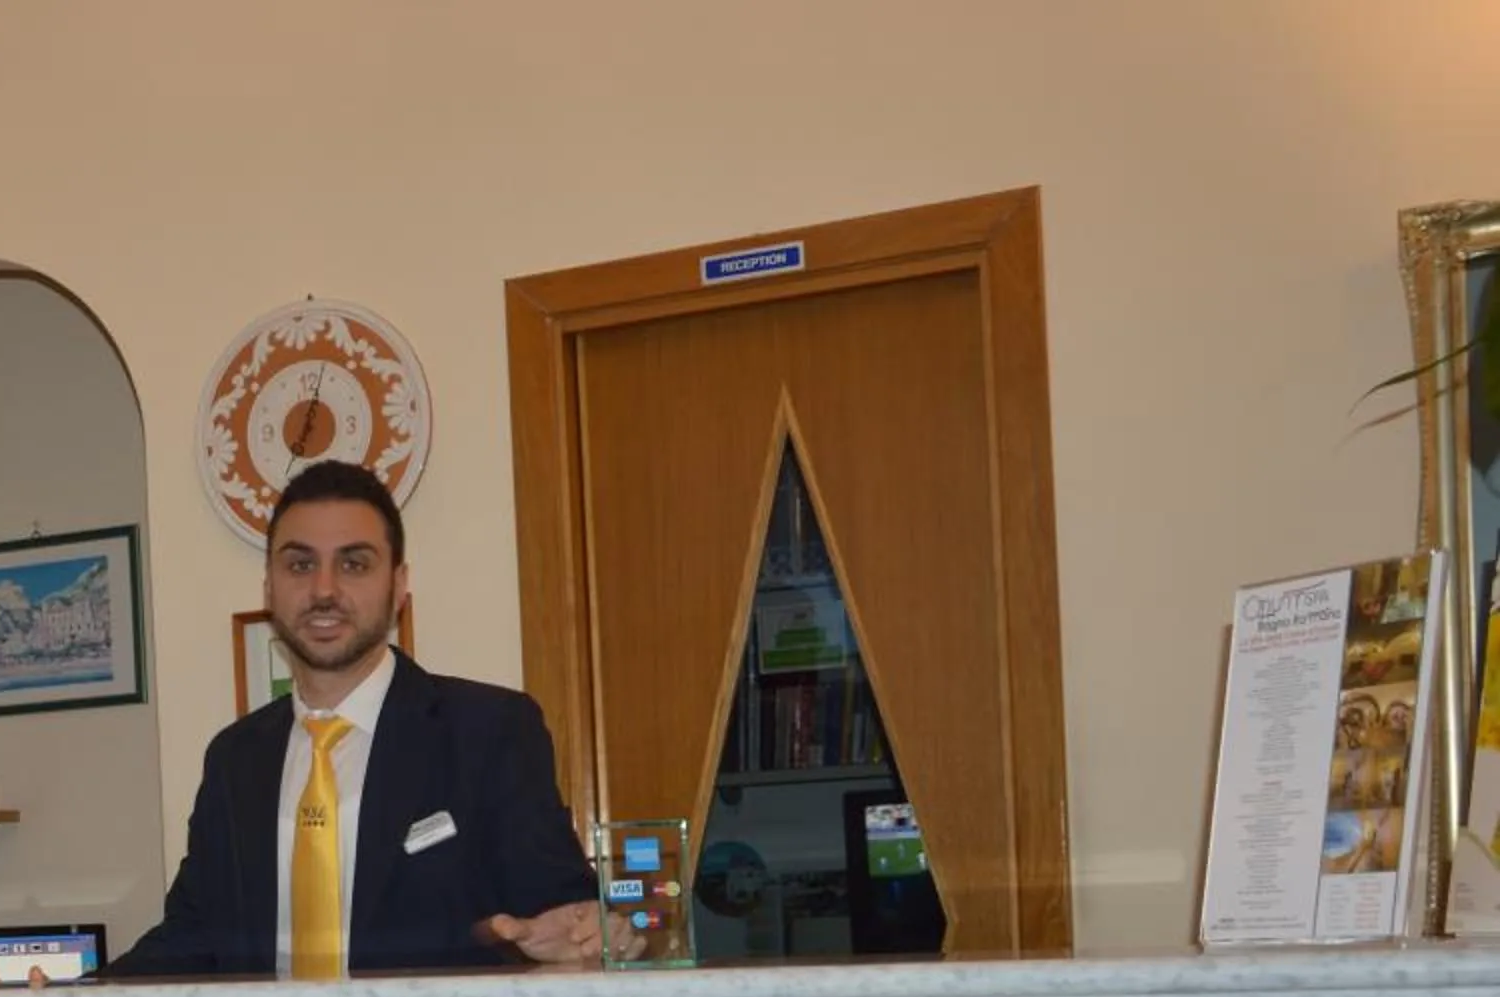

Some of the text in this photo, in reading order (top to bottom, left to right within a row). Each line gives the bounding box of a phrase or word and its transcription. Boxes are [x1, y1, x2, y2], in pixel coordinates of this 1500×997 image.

[721, 253, 787, 272] RECEPTION
[299, 373, 319, 393] 12
[346, 415, 357, 435] 3
[612, 883, 641, 894] VISA
